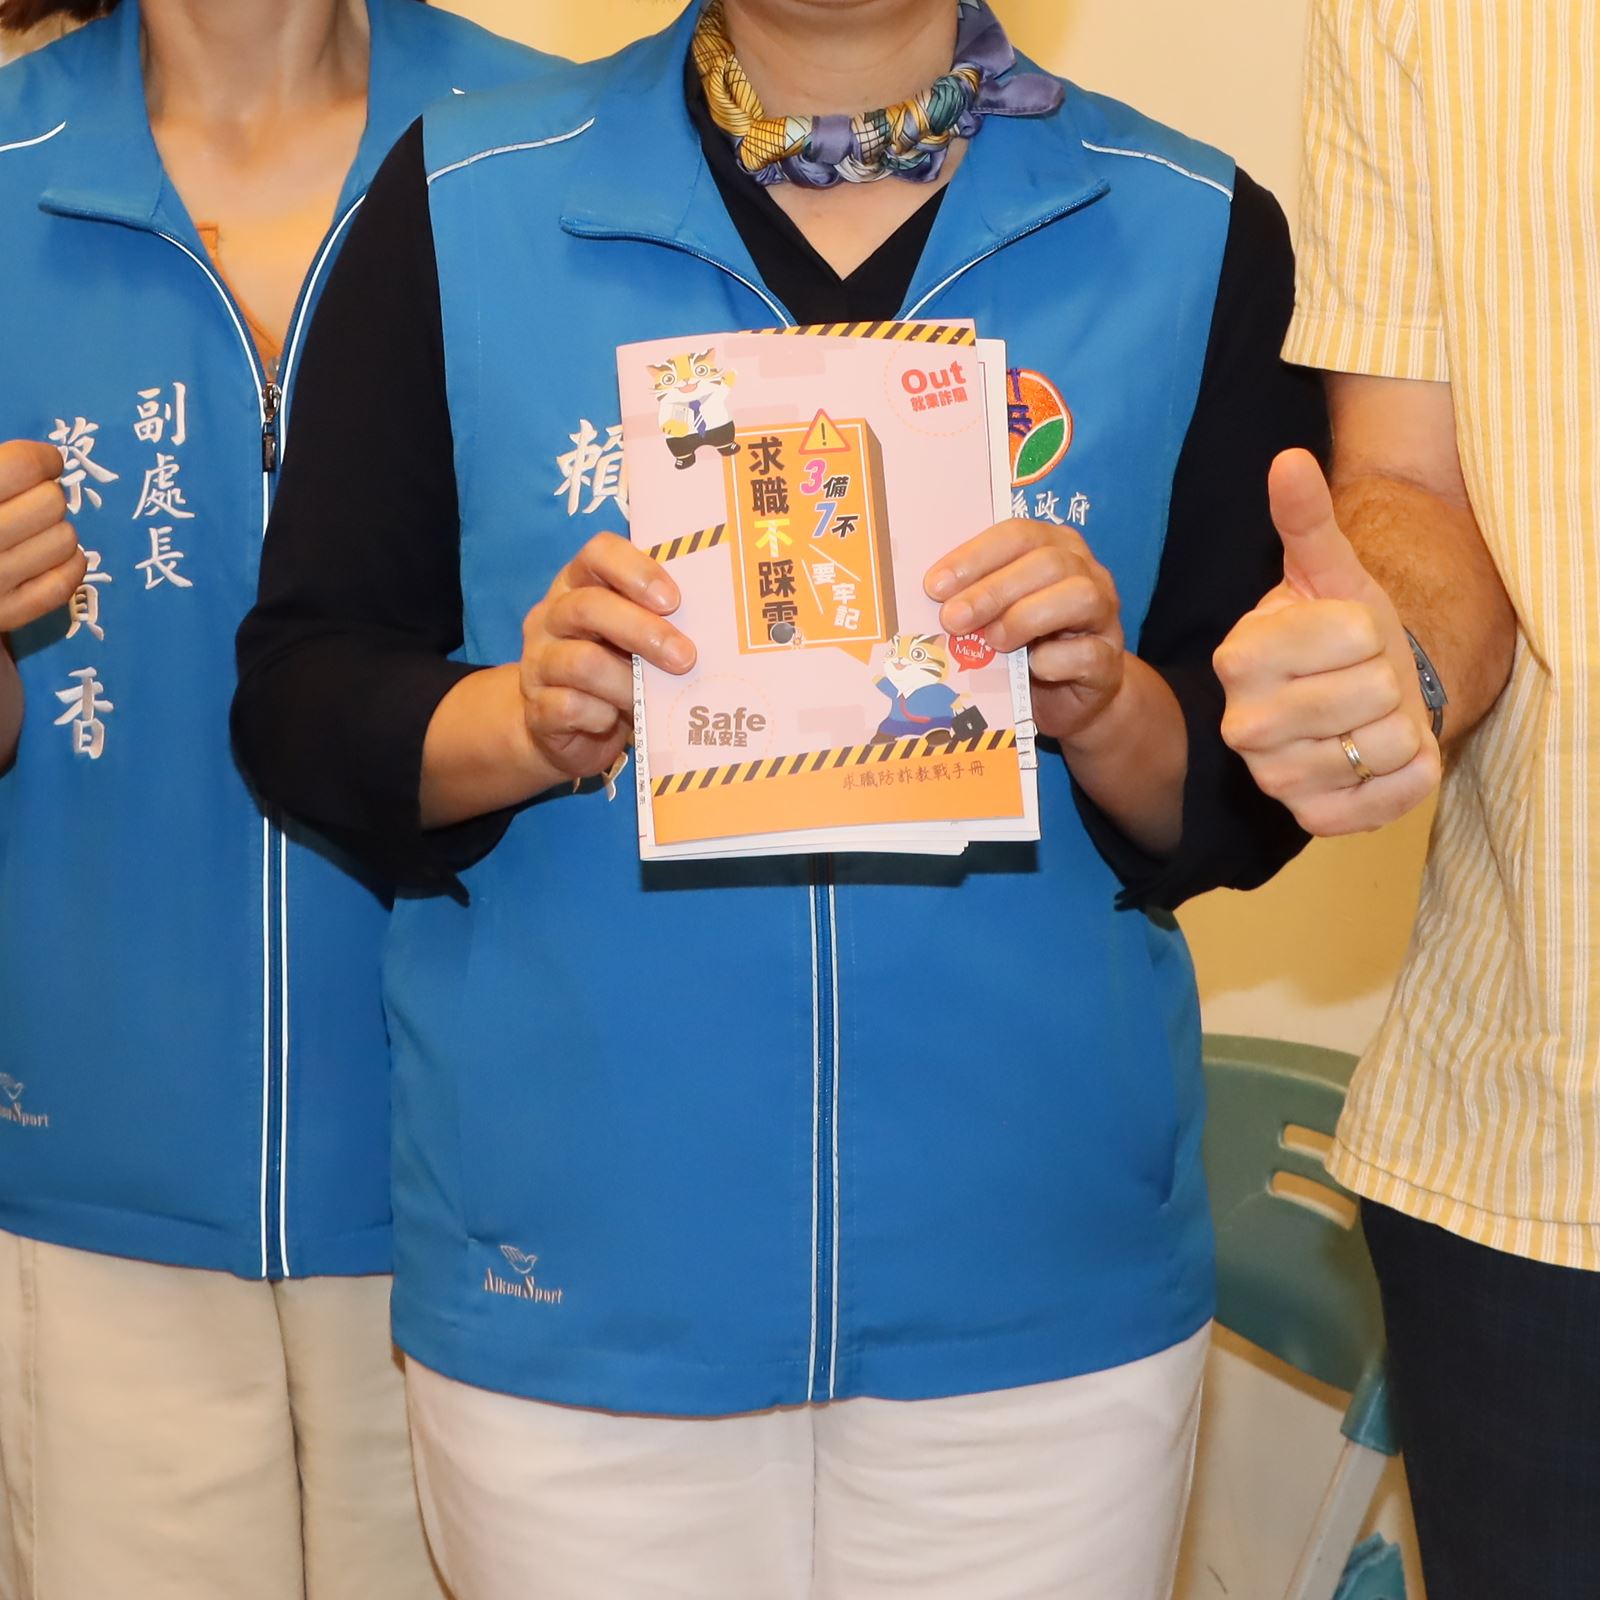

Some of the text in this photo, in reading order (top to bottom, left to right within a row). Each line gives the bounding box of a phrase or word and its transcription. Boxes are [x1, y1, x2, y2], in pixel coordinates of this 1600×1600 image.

[901, 360, 966, 394] Out
[132, 382, 195, 590] 副處長
[688, 705, 766, 732] Safe
